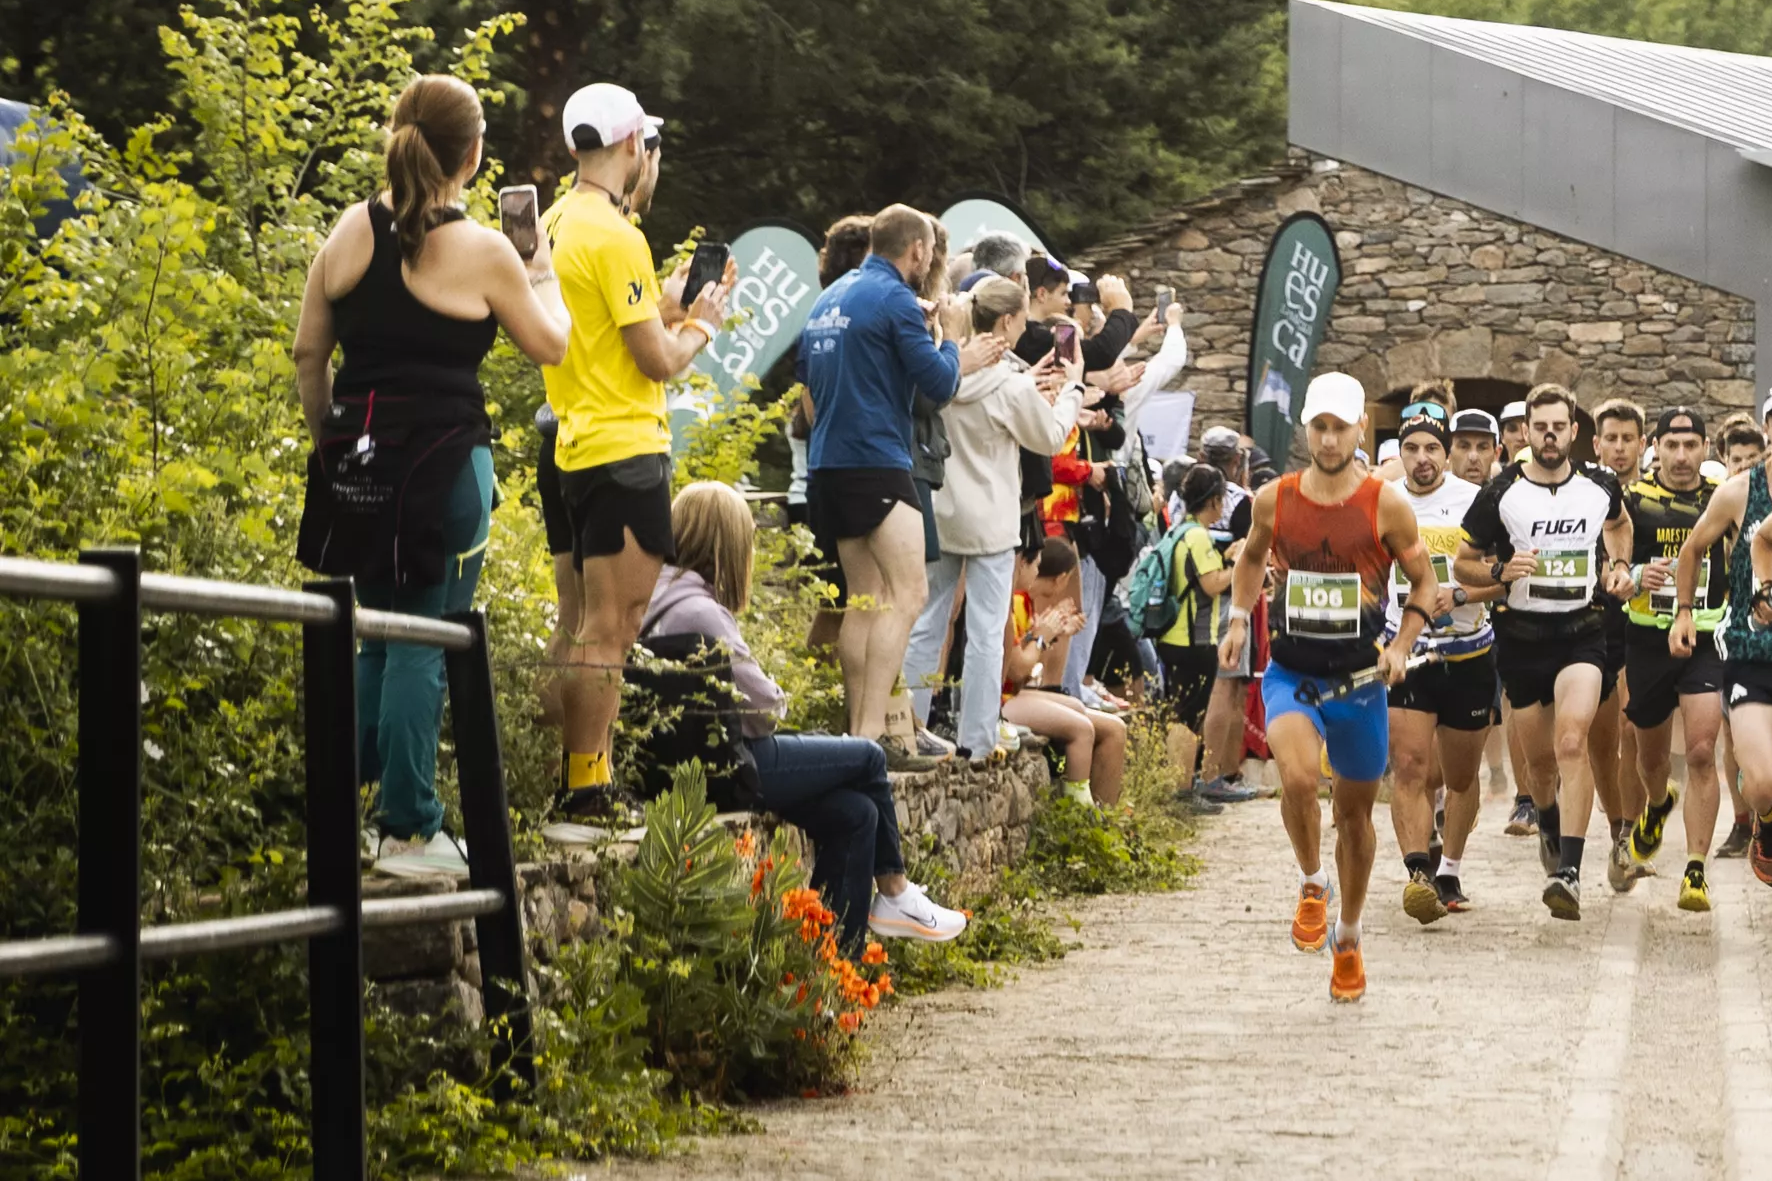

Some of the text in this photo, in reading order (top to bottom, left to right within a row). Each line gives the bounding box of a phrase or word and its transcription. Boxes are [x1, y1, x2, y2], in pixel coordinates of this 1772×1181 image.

[1531, 518, 1587, 537] FUGA
[1543, 559, 1577, 576] 124
[1302, 587, 1343, 608] 106
